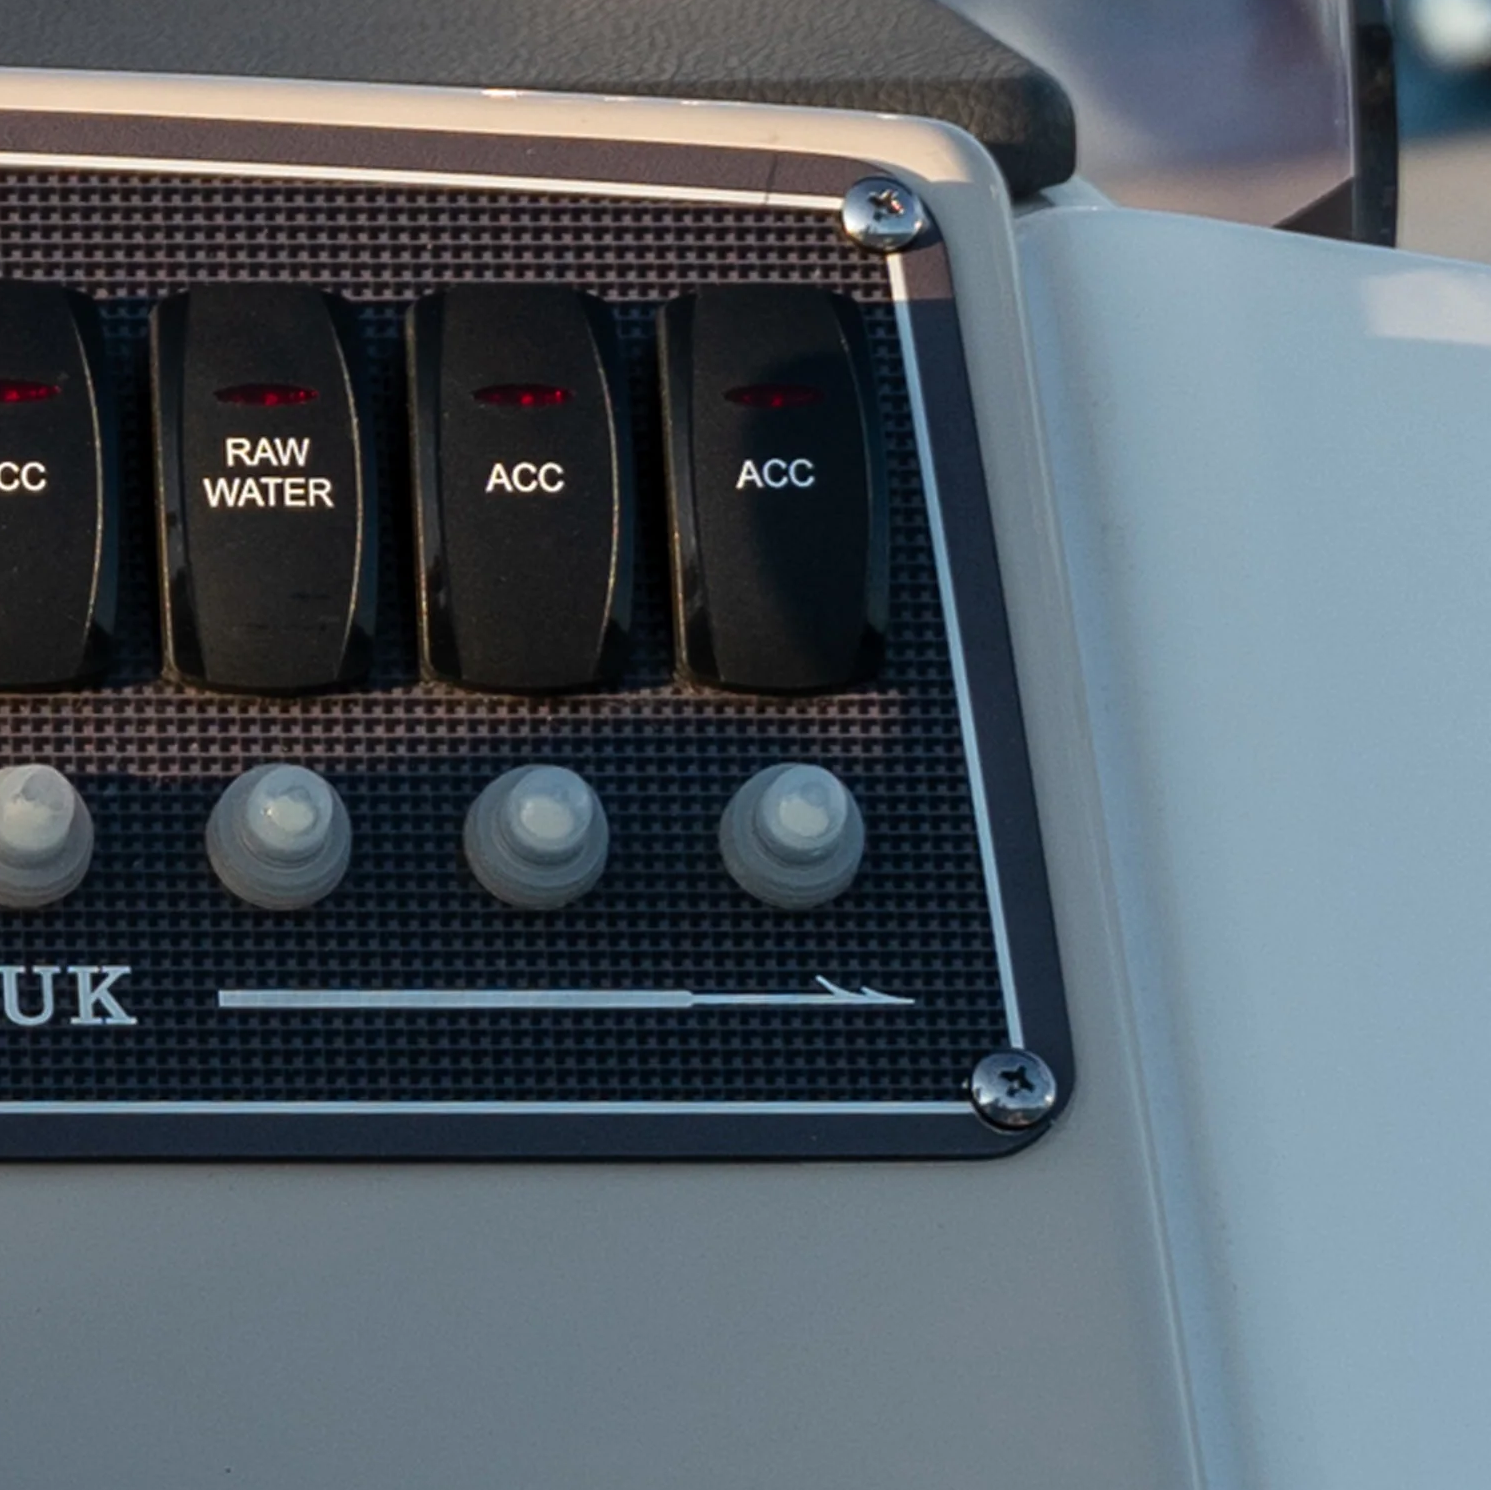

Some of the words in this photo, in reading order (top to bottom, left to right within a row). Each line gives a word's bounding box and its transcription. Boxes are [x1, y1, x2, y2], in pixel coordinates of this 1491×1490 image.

[225, 437, 310, 467] RAW
[485, 462, 564, 493] ACC
[736, 459, 814, 489] ACC
[203, 477, 334, 508] WATER
